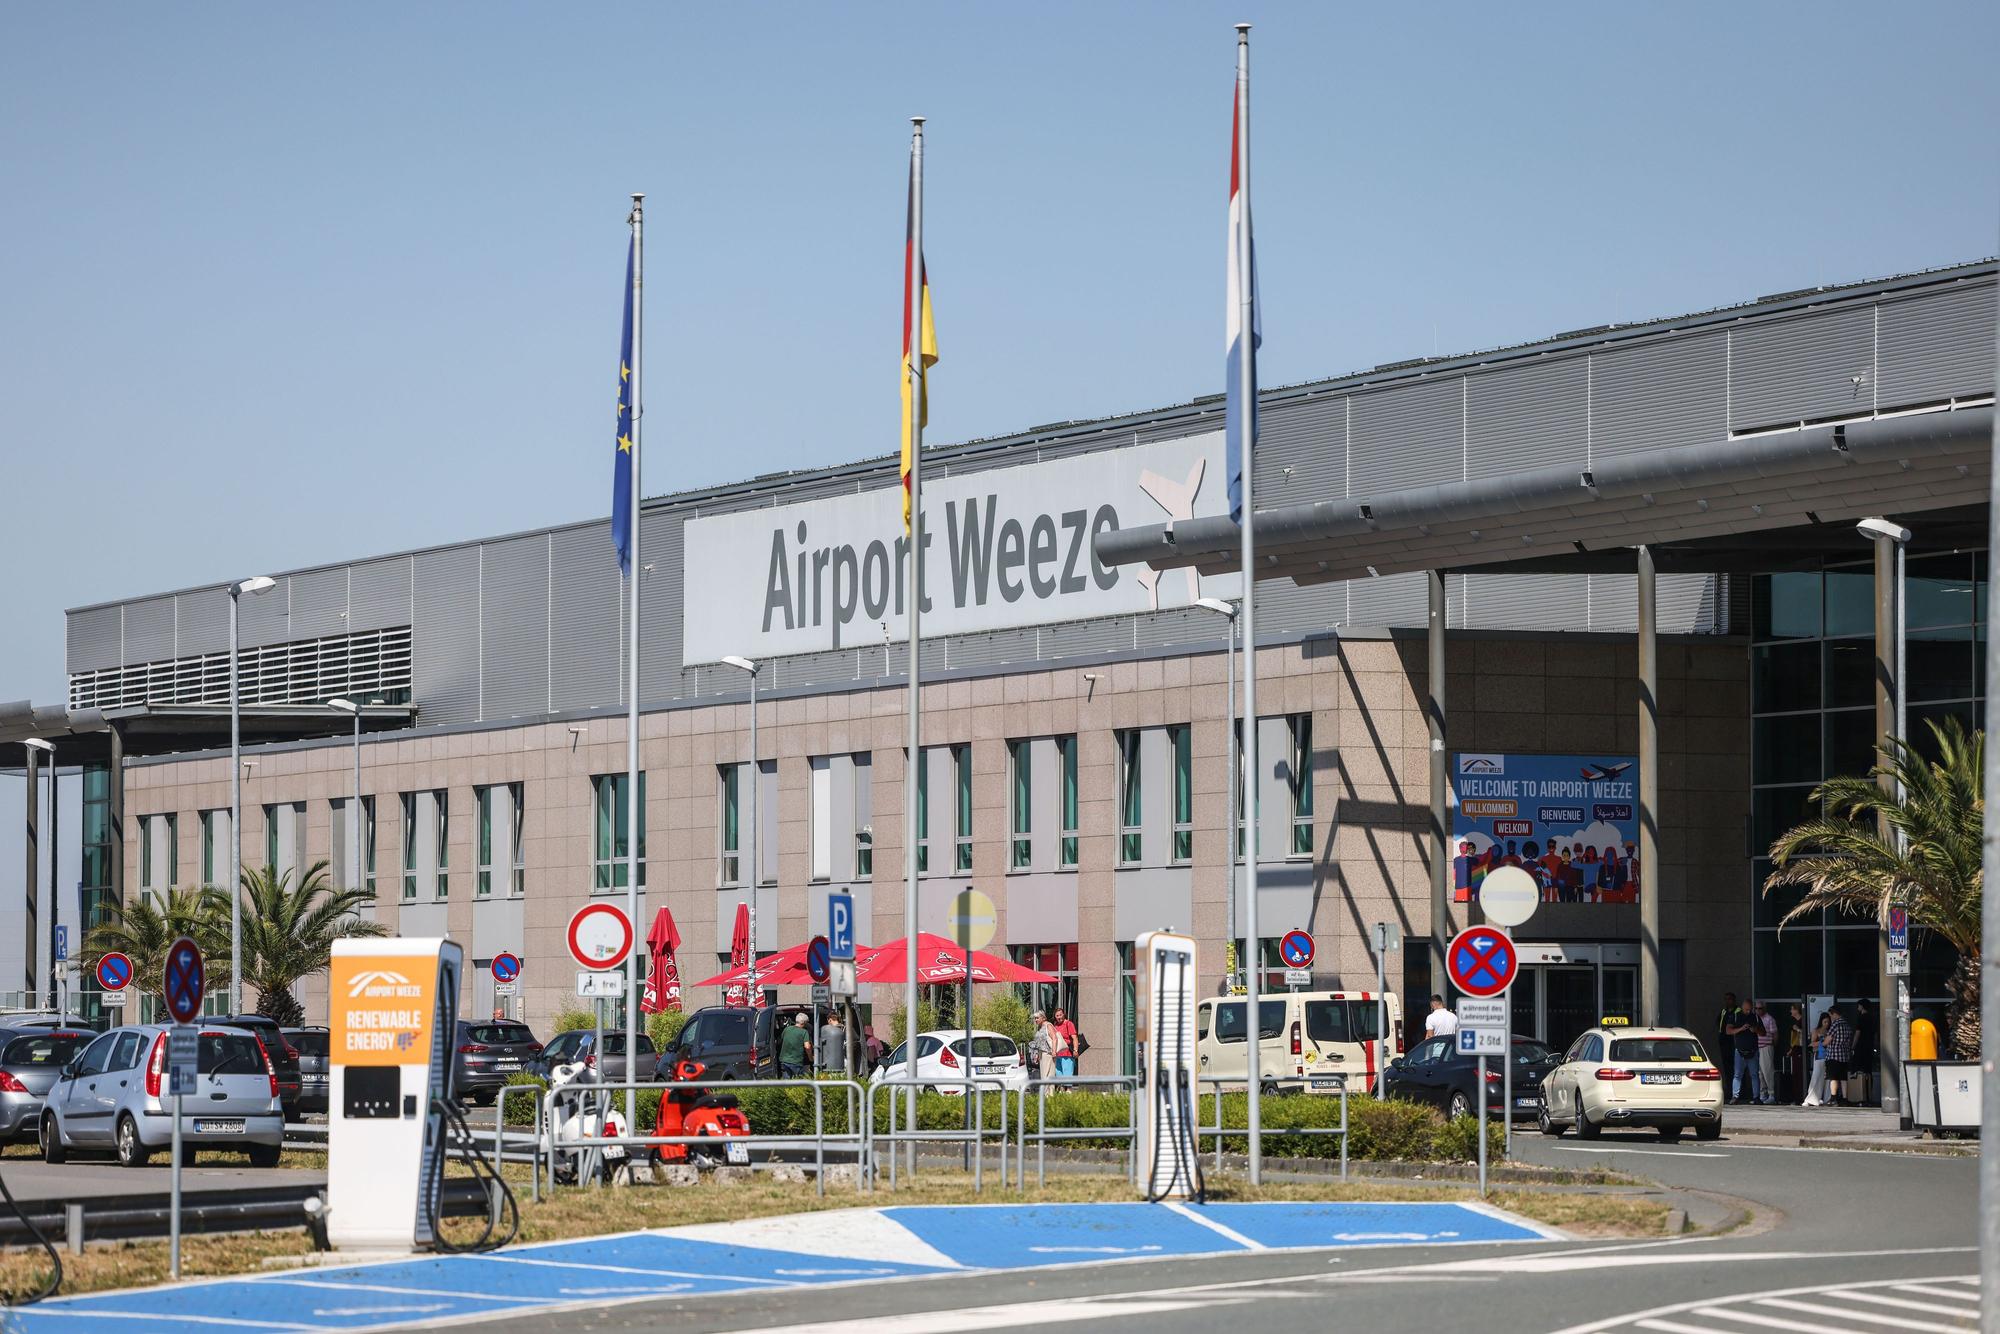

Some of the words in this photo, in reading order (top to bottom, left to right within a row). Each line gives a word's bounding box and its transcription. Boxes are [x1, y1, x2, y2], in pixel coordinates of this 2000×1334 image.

[762, 510, 932, 649] Airport
[945, 494, 1120, 608] Weeze
[1460, 779, 1519, 797] WELCOME
[1521, 780, 1537, 797] TO
[1539, 780, 1590, 798] AIRPORT
[1592, 781, 1633, 799] WEEZE
[1465, 802, 1514, 814] WILLKOMMEN
[1541, 809, 1582, 821] BIENVENUE
[1497, 823, 1529, 834] WELKOM
[834, 902, 848, 950] P
[1890, 935, 1905, 946] TAXI
[602, 981, 617, 989] frei
[1463, 1004, 1490, 1012] während
[1491, 1004, 1503, 1012] des
[346, 1010, 422, 1029] RENEWABLE
[1460, 1013, 1505, 1021] Ladevorgangs
[346, 1031, 395, 1051] ENERGY
[1479, 1035, 1484, 1046] 2
[1486, 1035, 1503, 1046] Std.
